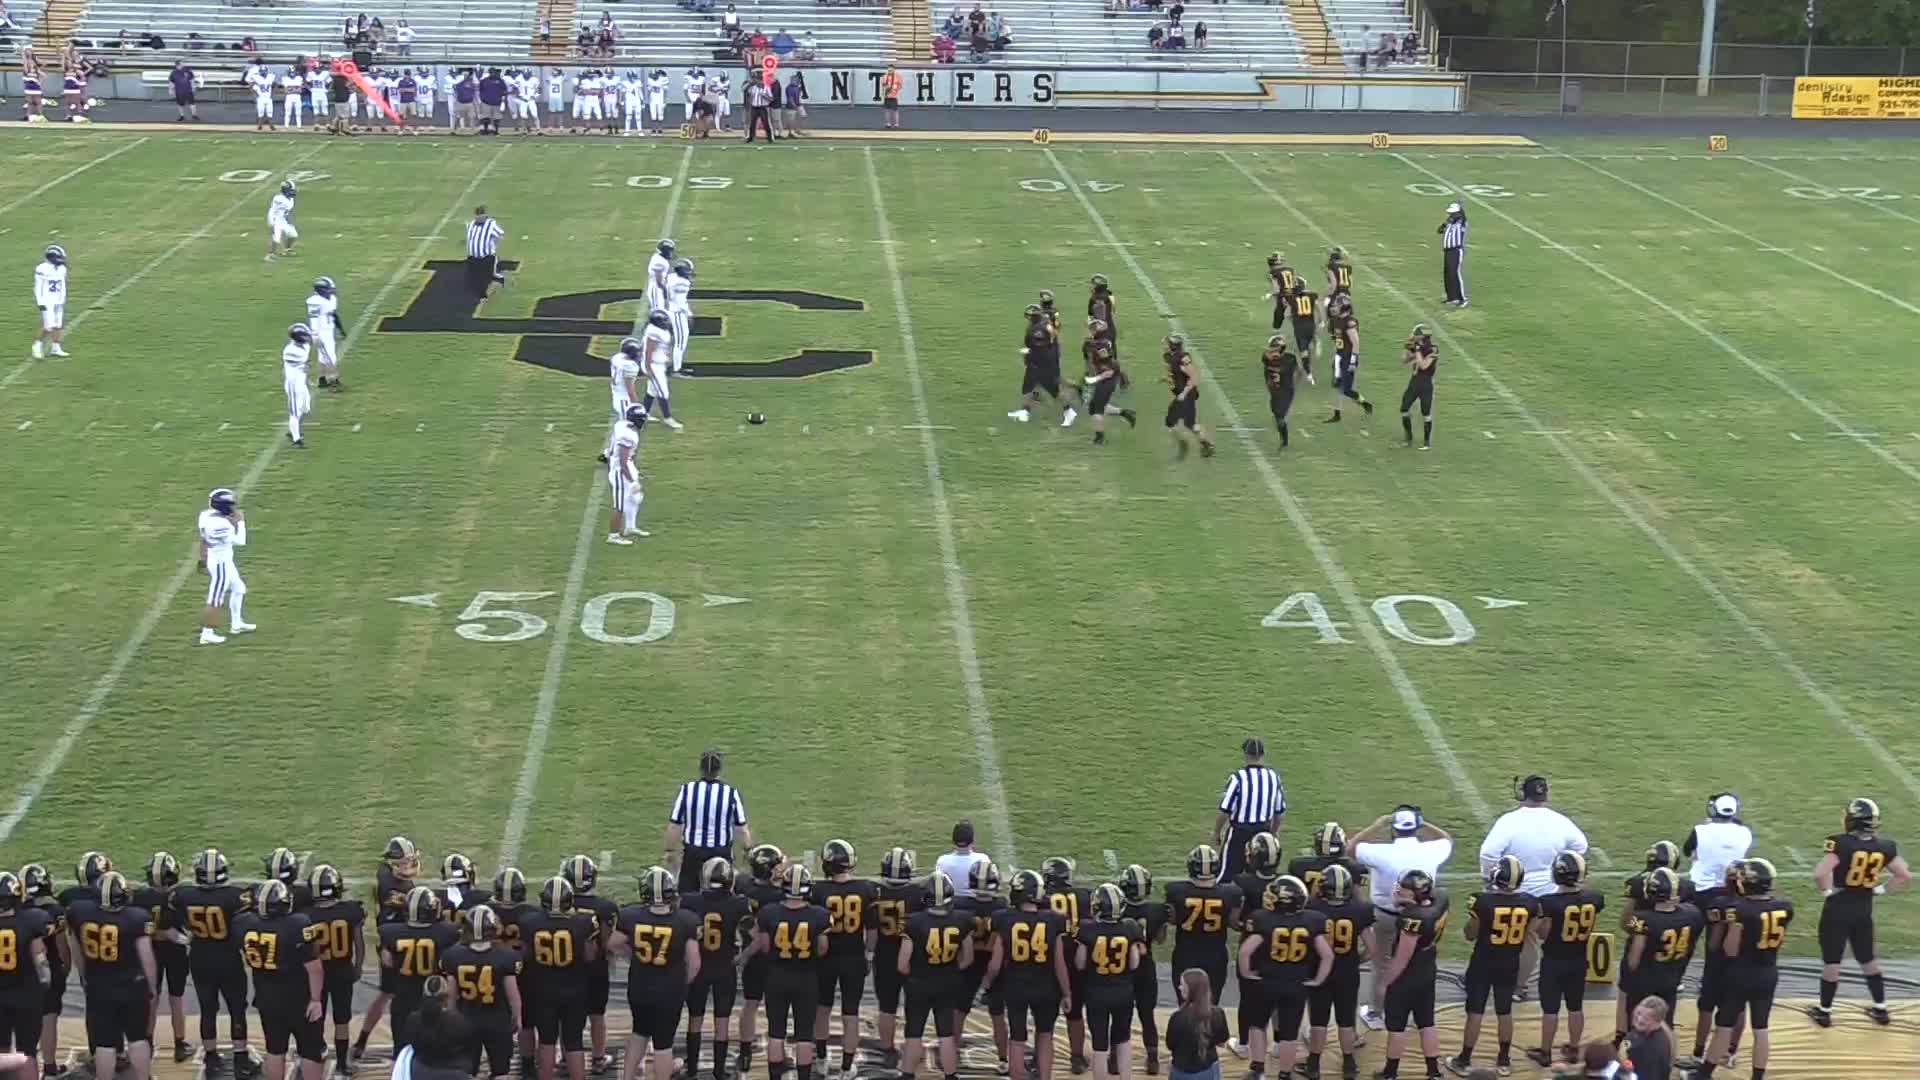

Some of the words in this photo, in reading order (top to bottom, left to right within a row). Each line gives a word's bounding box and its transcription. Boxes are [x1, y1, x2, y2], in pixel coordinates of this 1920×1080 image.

[797, 71, 1053, 102] ANTHERS
[1034, 130, 1048, 142] 40
[1374, 134, 1388, 147] 30
[1712, 137, 1726, 149] 20
[1296, 296, 1312, 316] 10
[454, 591, 677, 645] 50
[1261, 592, 1476, 646] 40
[1845, 850, 1885, 889] 83
[186, 905, 227, 941] 50
[1181, 897, 1224, 933] 75
[1490, 906, 1529, 945] 58
[1561, 904, 1597, 943] 69
[1757, 910, 1788, 950] 15
[80, 921, 119, 961] 68
[243, 931, 278, 970] 67
[396, 937, 436, 977] 70
[534, 929, 574, 967] 60
[634, 923, 673, 966] 57
[774, 921, 811, 960] 44
[926, 927, 960, 964] 46
[1011, 922, 1048, 962] 64
[1092, 935, 1129, 975] 43
[1270, 927, 1310, 962] 66
[1586, 935, 1610, 977] 0
[1655, 926, 1691, 962] 34
[457, 964, 495, 1004] 54
